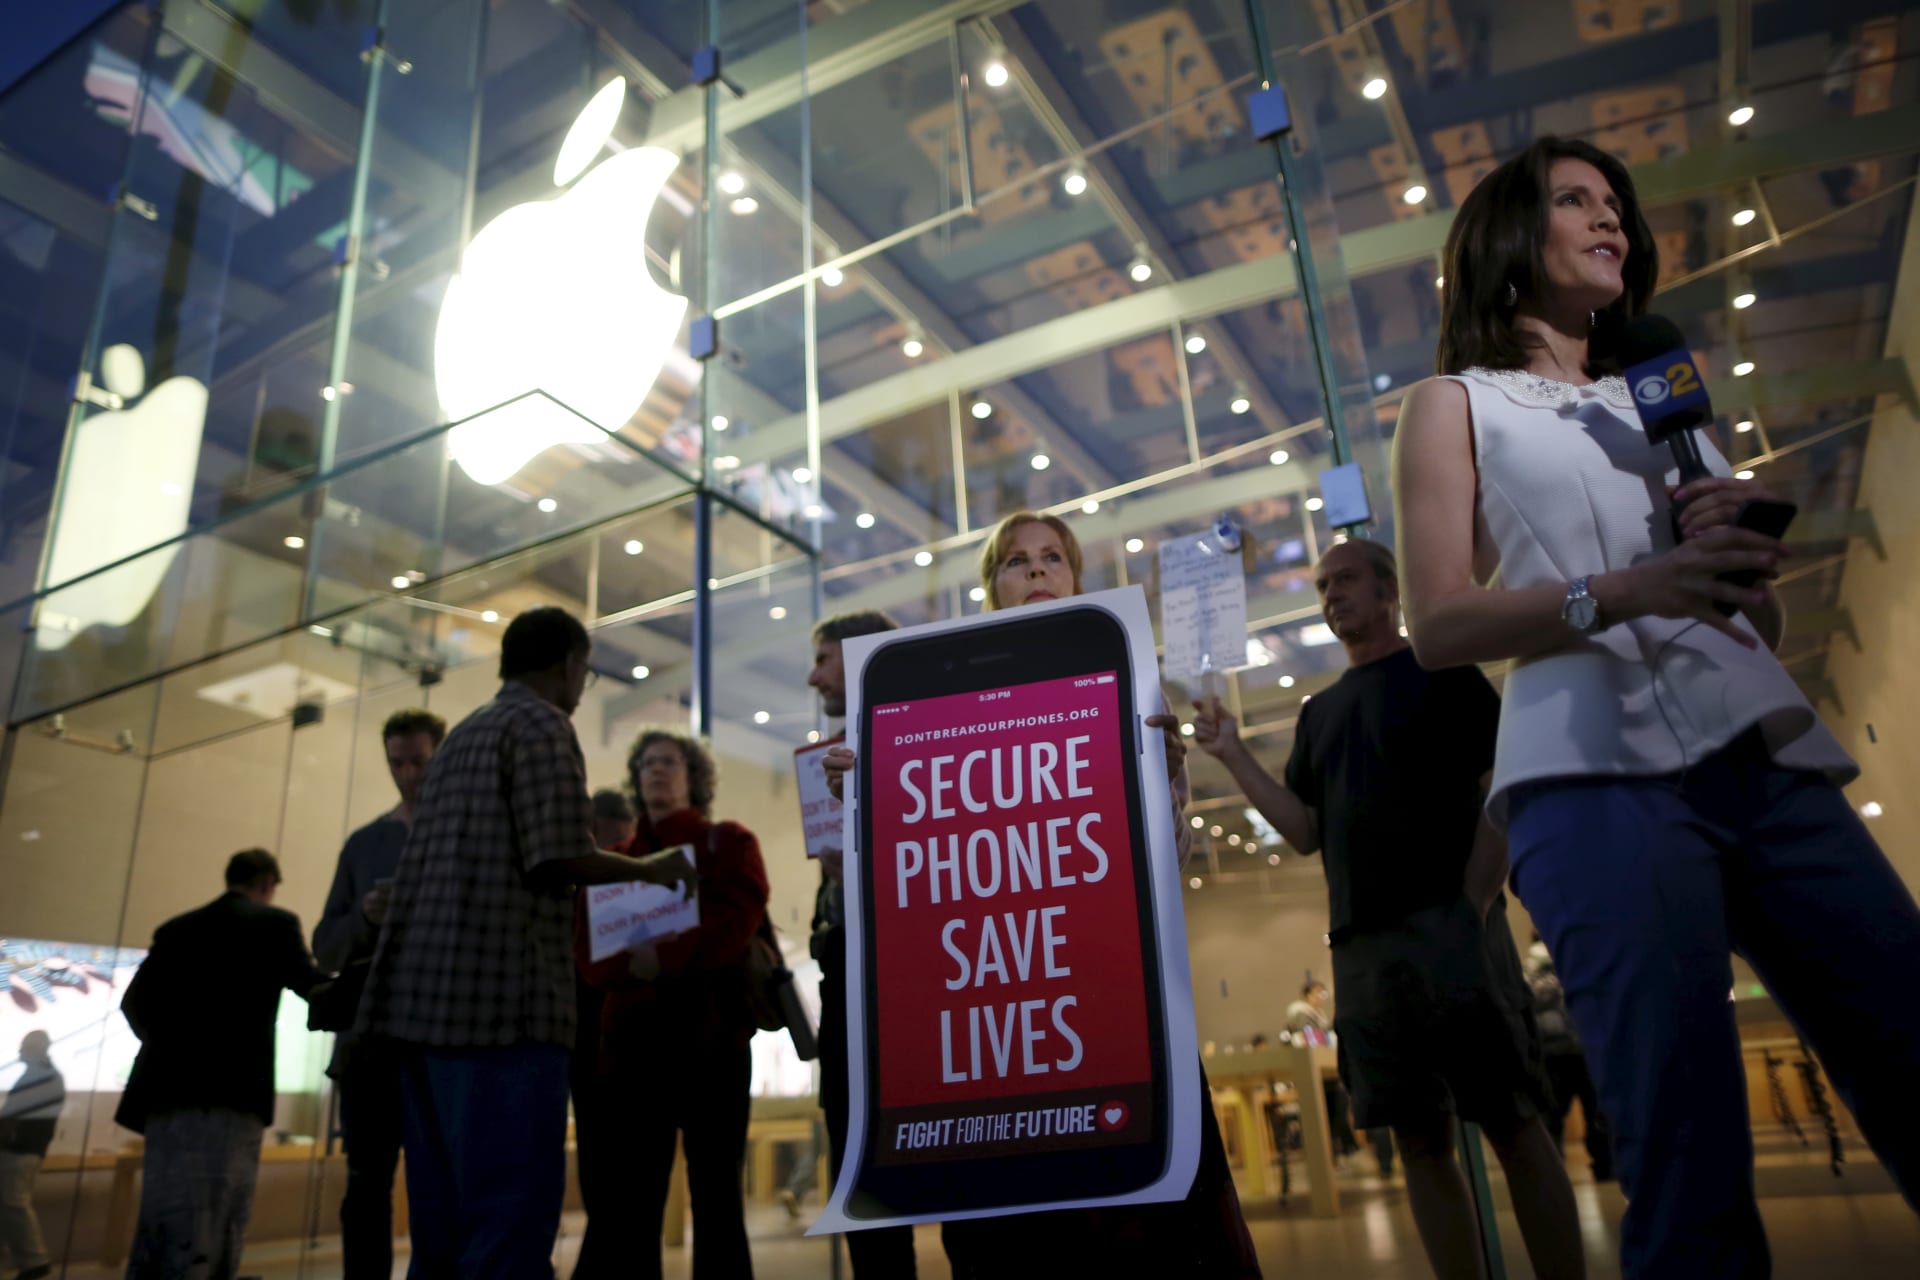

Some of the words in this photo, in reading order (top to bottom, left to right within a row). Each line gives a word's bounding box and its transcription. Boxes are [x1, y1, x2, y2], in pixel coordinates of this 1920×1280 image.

[1665, 362, 1699, 398] 2
[998, 690, 1011, 700] PM
[1073, 677, 1096, 688] 100%
[894, 707, 1100, 746] DONTBREAKOURPHONES.ORG
[899, 734, 1093, 824] SECURE
[896, 812, 1109, 908] PHONES
[941, 905, 1071, 991] SAVE
[940, 995, 1084, 1084] LIVES
[895, 1119, 955, 1150] FIGHT
[1014, 1104, 1097, 1139] FUTURE
